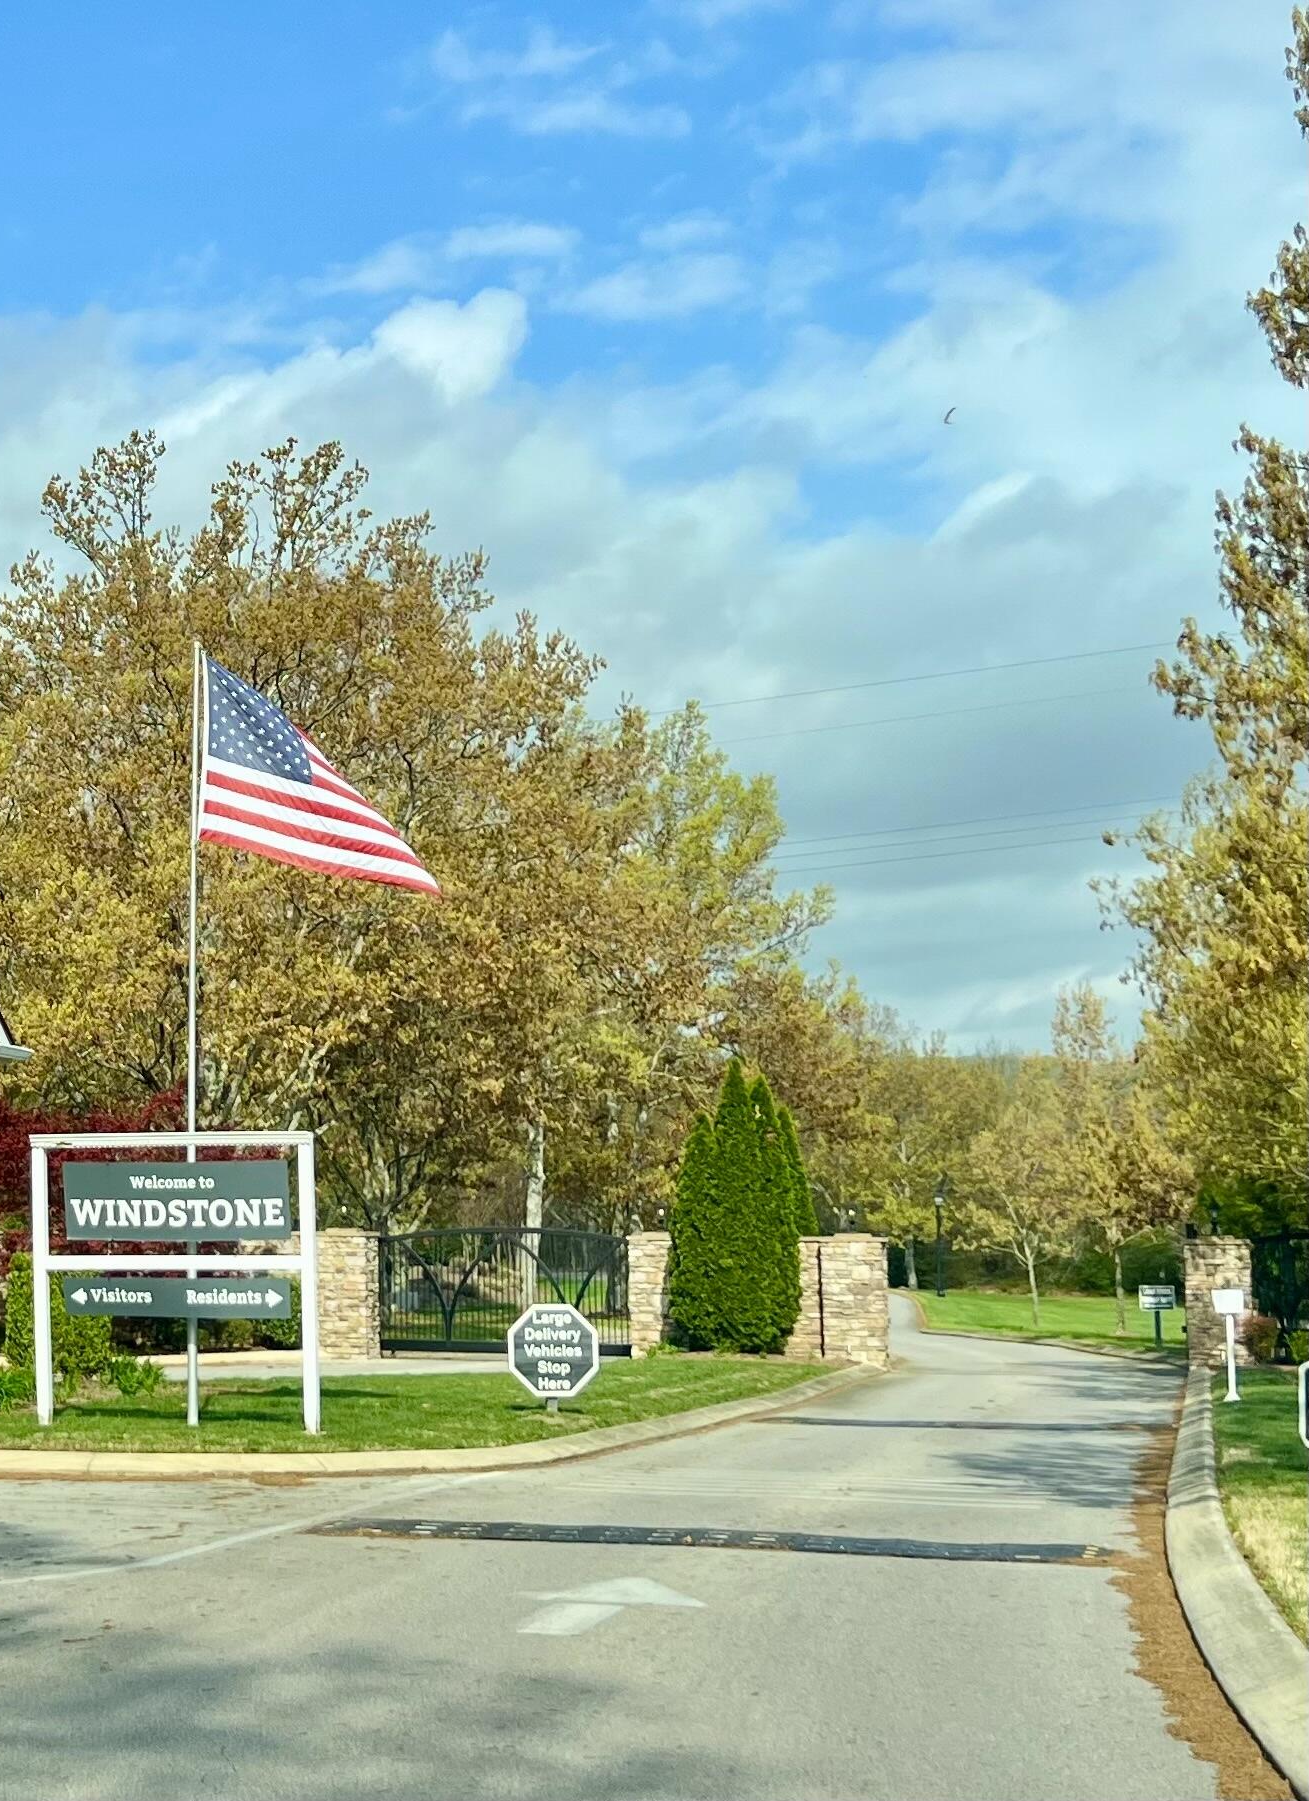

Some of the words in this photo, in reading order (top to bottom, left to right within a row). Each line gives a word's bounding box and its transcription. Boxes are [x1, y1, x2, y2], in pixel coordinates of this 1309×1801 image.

[129, 1175, 196, 1189] Welcome
[198, 1175, 215, 1189] to
[70, 1199, 285, 1227] WINDSTONE
[90, 1288, 153, 1304] Visitors
[186, 1289, 262, 1305] Residents
[532, 1311, 572, 1327] Large
[524, 1327, 581, 1343] Delivery
[524, 1343, 582, 1357] Vehicles
[537, 1360, 571, 1376] Stop
[538, 1377, 571, 1390] Here
